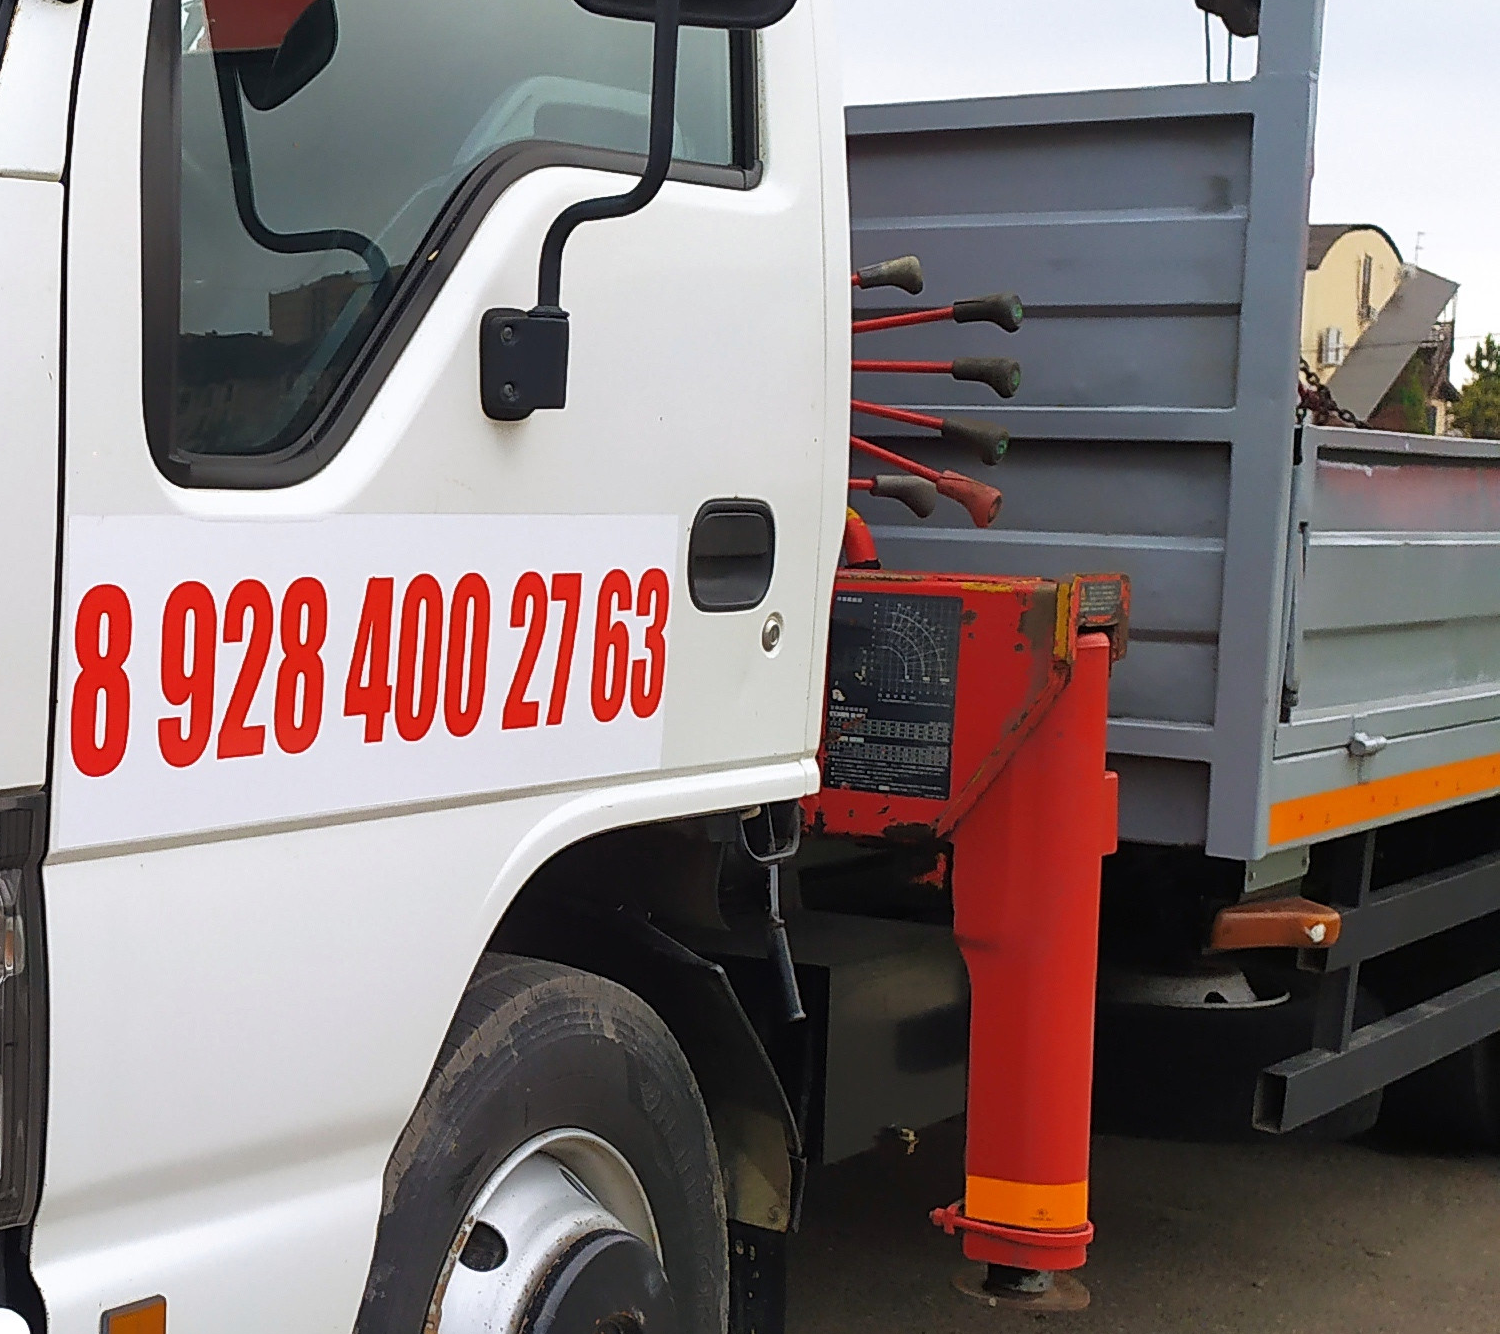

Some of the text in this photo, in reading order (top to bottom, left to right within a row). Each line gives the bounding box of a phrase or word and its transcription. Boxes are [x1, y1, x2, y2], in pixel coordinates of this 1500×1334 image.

[70, 567, 670, 778] 8 928 400 27 63
